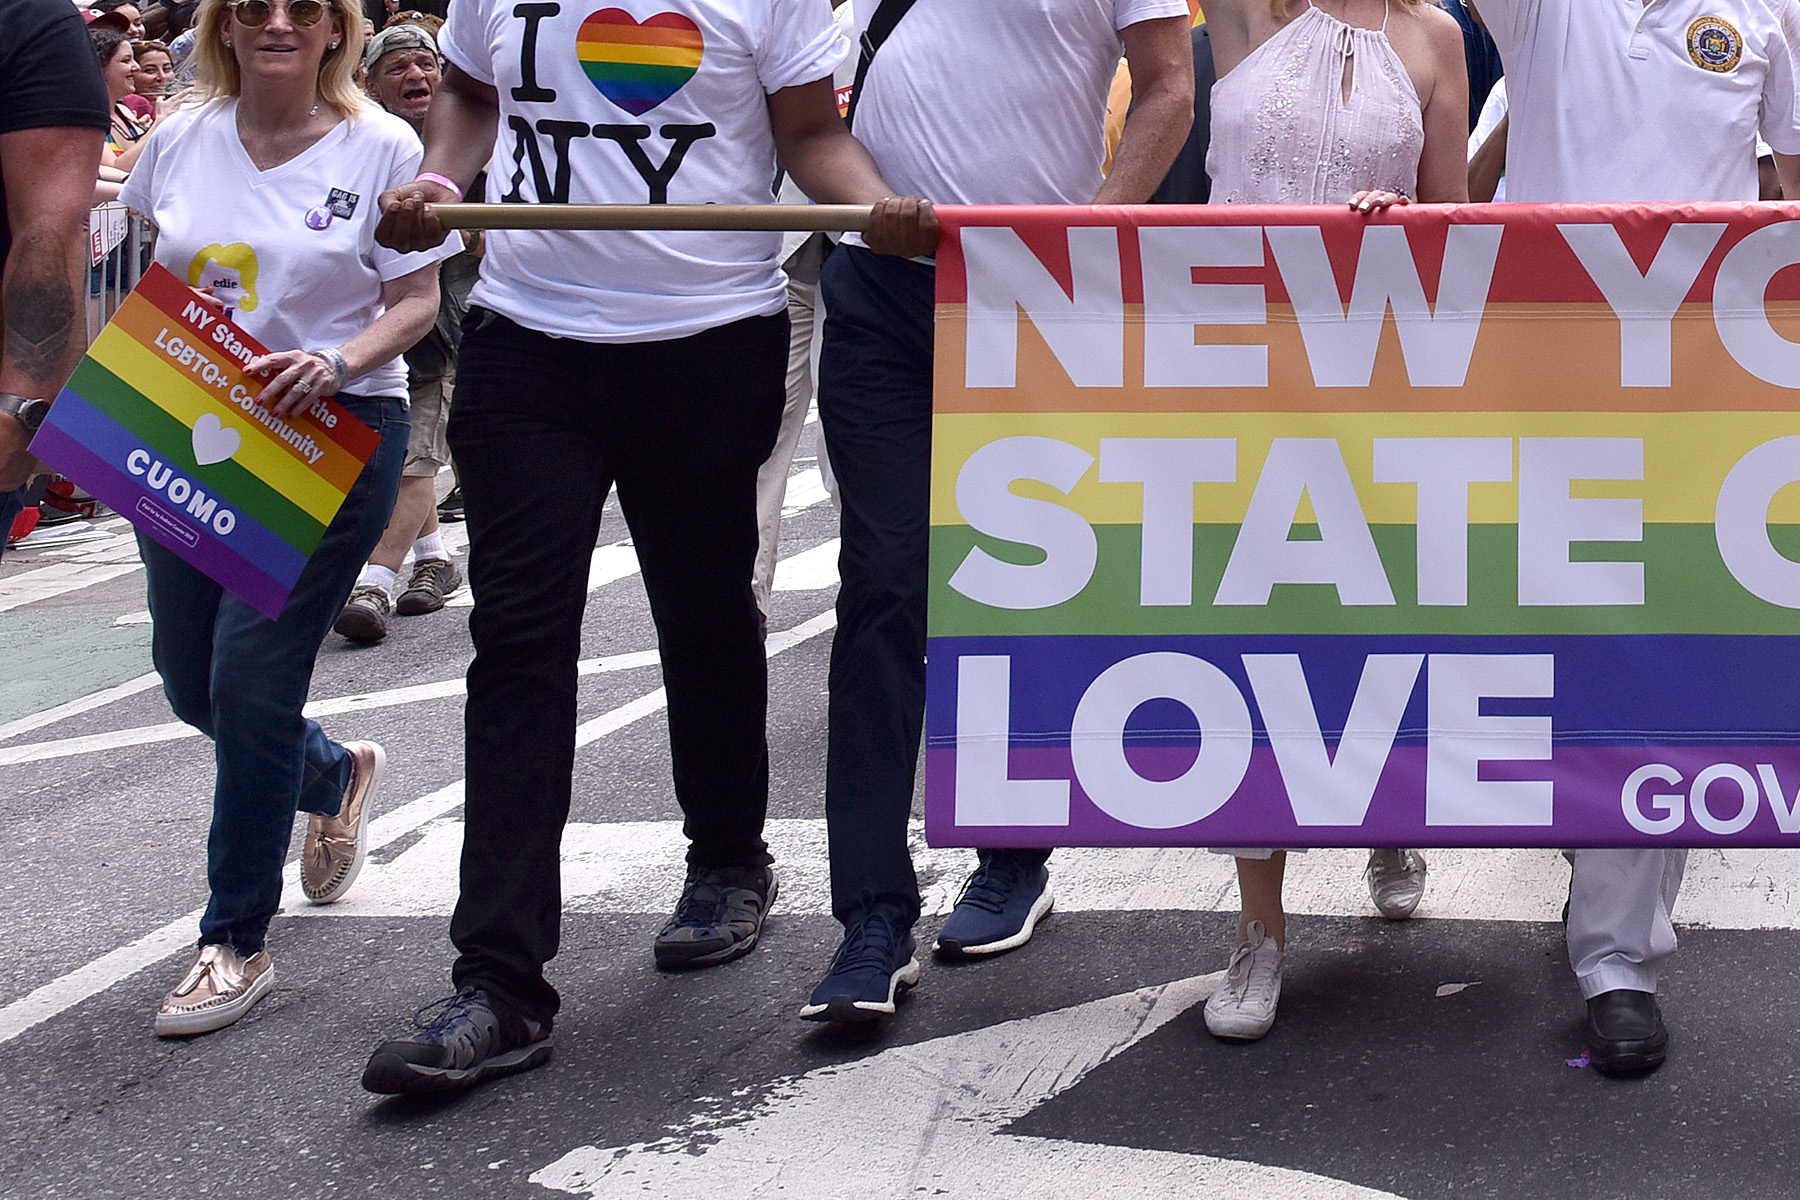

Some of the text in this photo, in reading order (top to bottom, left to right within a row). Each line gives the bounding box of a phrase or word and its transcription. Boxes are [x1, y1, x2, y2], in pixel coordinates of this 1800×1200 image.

[510, 2, 561, 103] I
[501, 114, 717, 204] NY
[213, 278, 238, 289] edie
[959, 224, 1505, 389] NEW
[153, 327, 325, 466] LGBTQ+ Community
[181, 300, 215, 331] NY
[310, 400, 337, 430] the
[126, 449, 236, 536] CUOMO
[947, 435, 1645, 611] STATE
[954, 651, 1555, 829] LOVE
